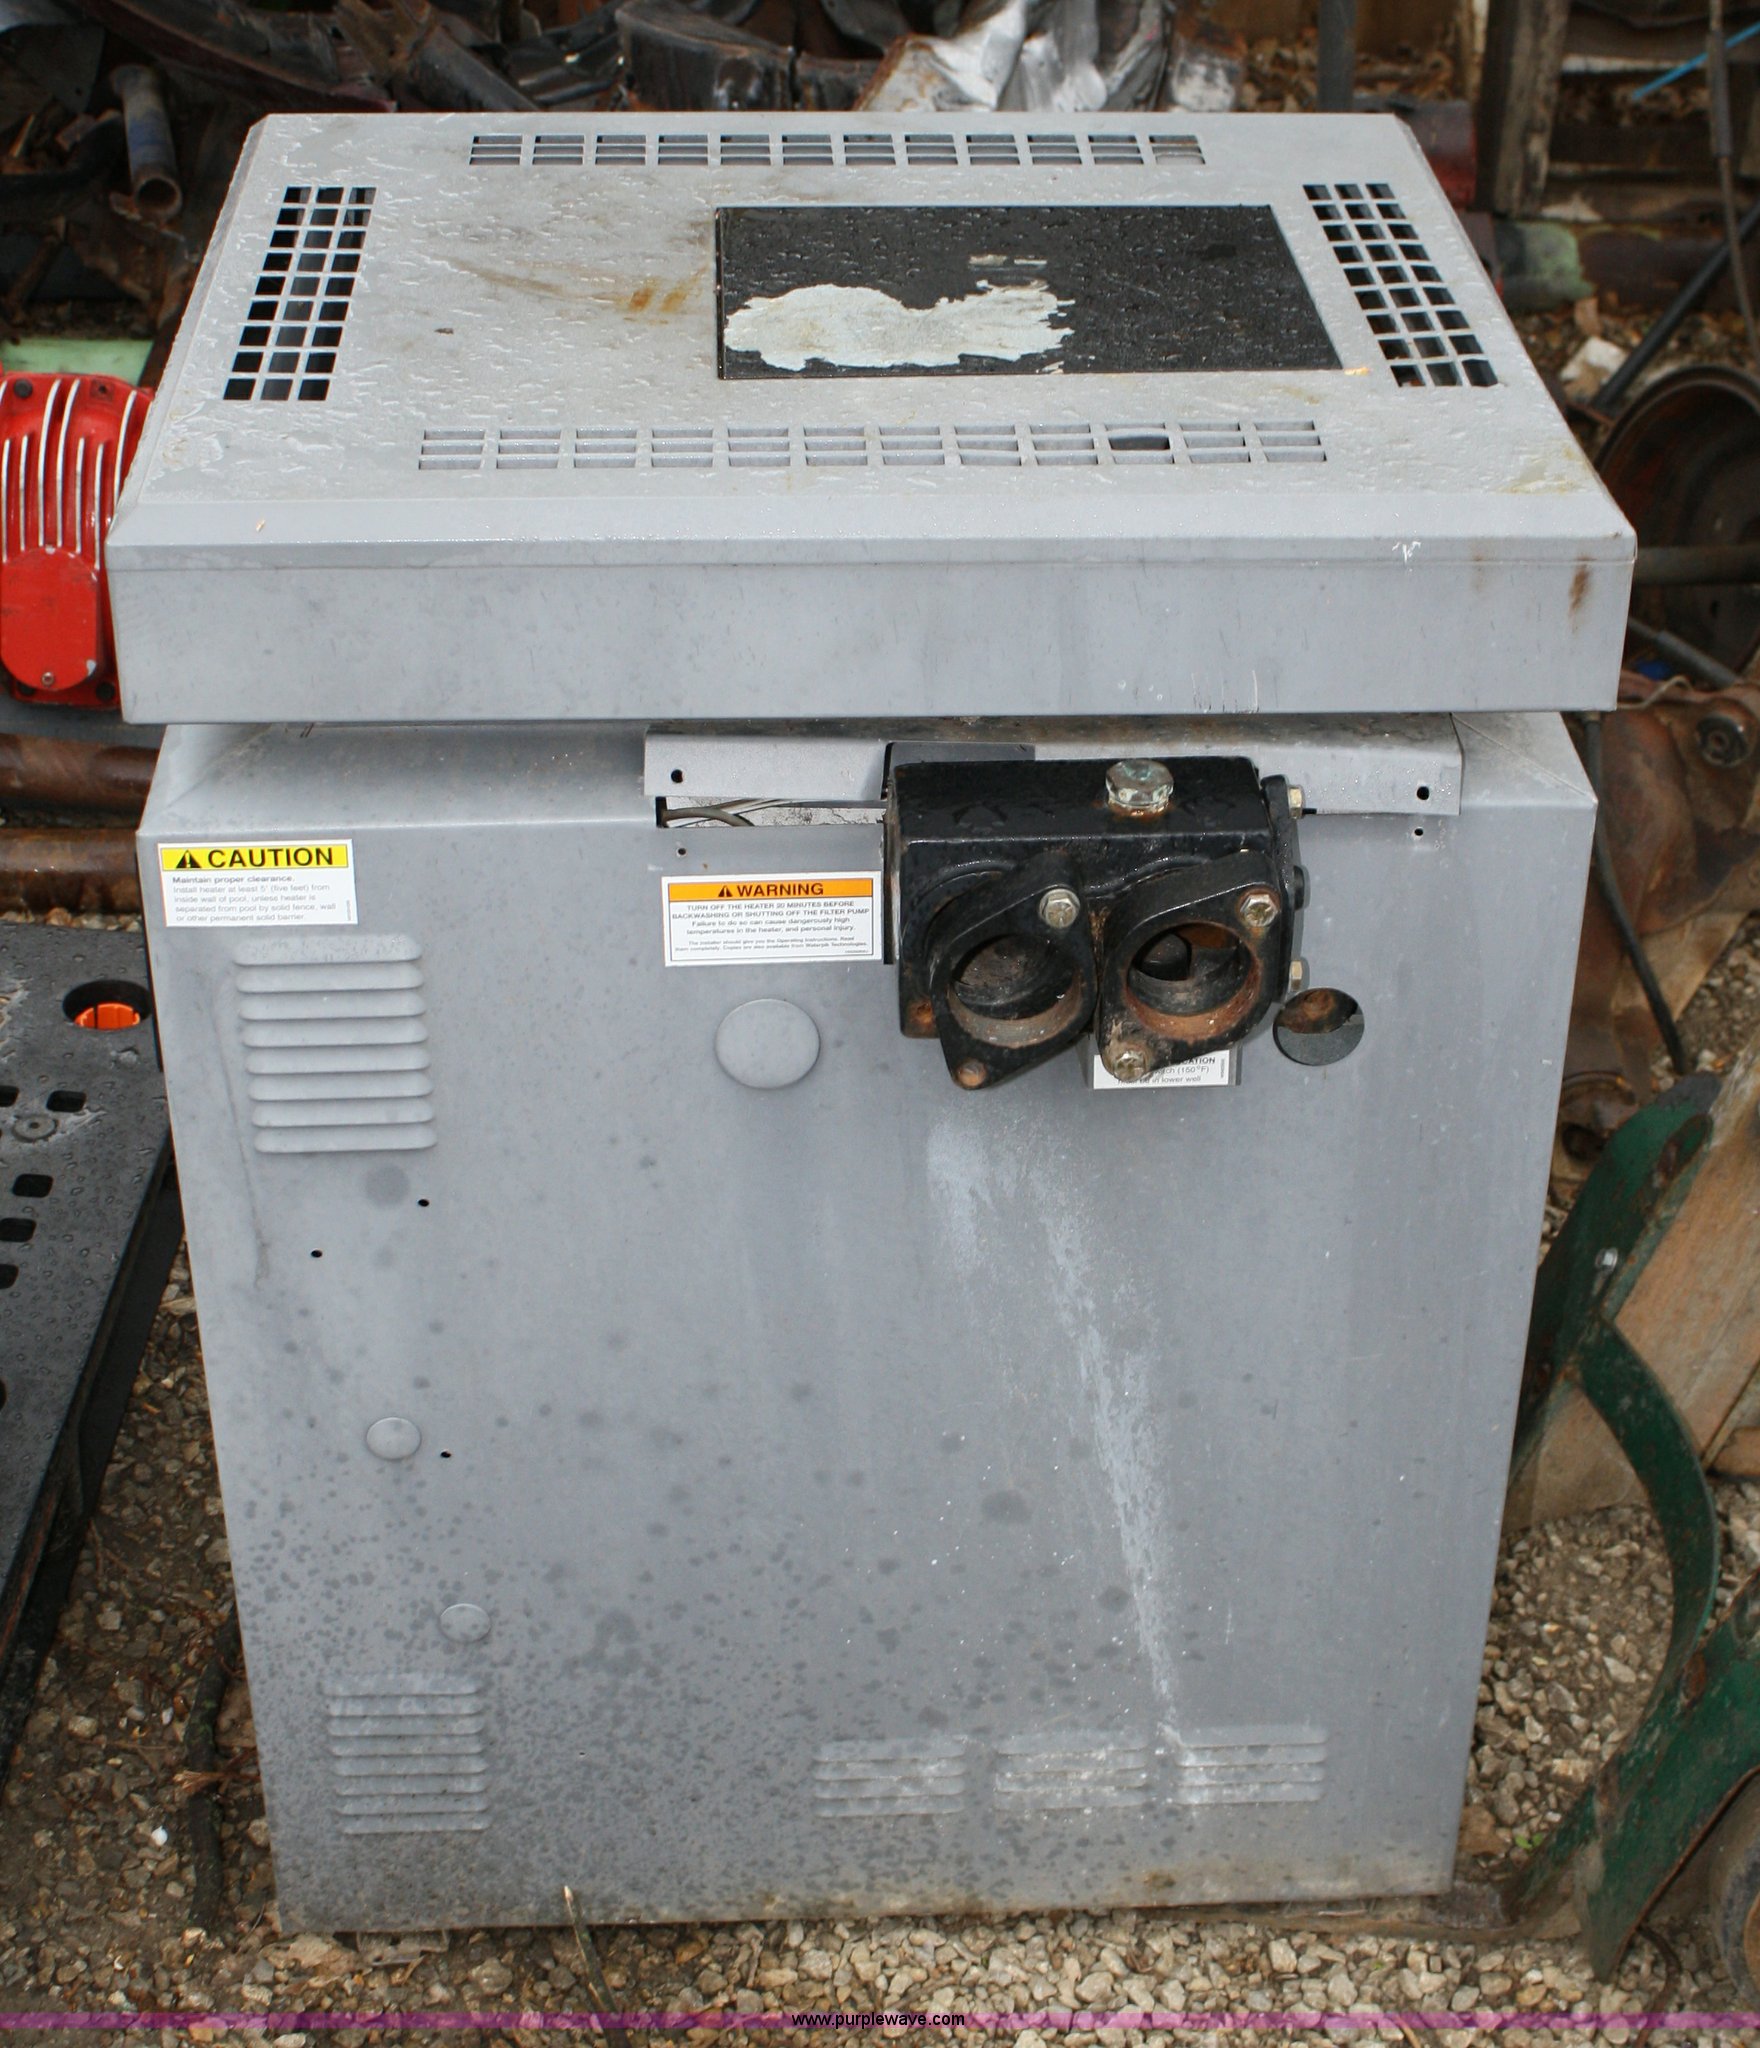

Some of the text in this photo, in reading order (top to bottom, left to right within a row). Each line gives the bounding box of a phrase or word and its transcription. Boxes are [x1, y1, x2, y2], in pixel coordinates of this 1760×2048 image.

[208, 847, 333, 868] CAUTION
[271, 884, 289, 893] (five
[290, 884, 310, 892] feet)
[737, 883, 824, 897] WARNING
[239, 905, 257, 913] pool
[259, 904, 269, 912] by
[210, 915, 254, 923] permanent
[1161, 1076, 1183, 1084] lower
